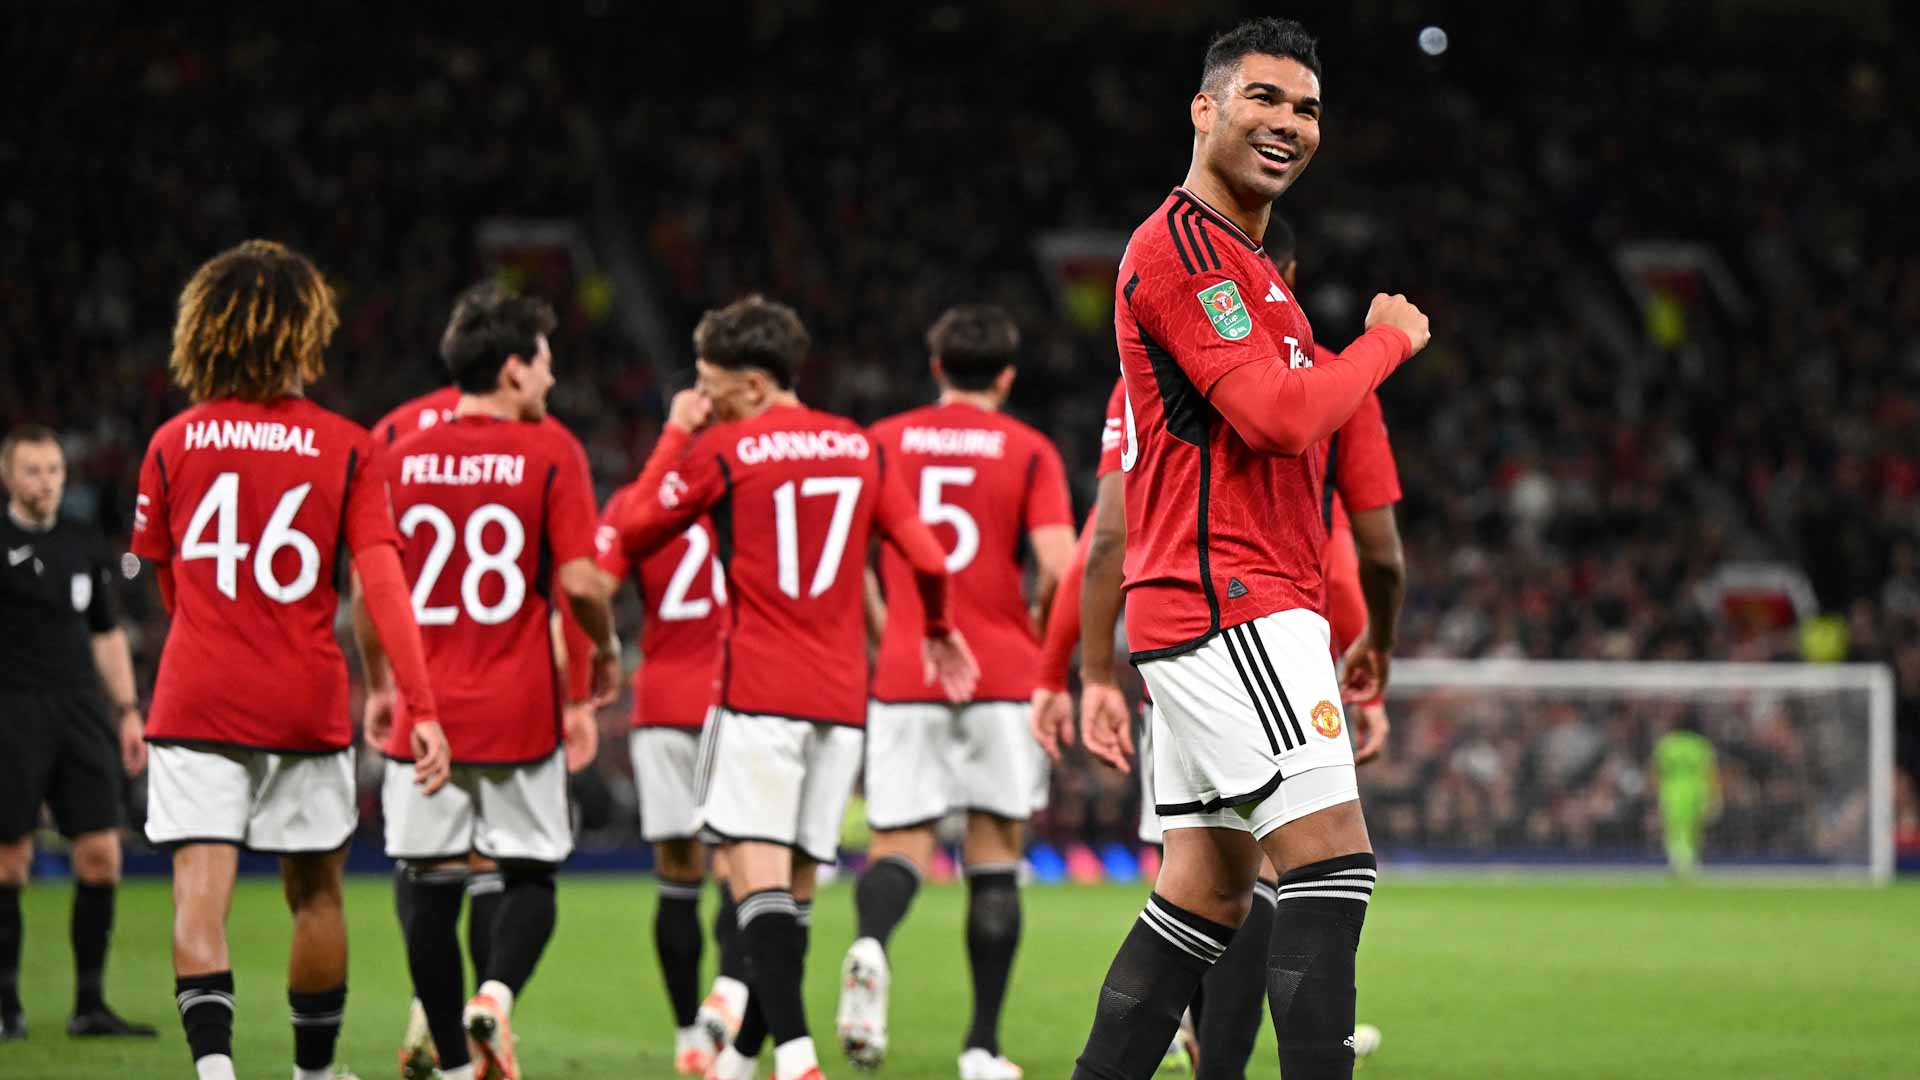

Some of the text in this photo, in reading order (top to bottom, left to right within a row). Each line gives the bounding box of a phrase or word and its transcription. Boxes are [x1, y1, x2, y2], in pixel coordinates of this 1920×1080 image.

[184, 419, 320, 457] HANNIBAL
[401, 453, 526, 486] PELLISTRI
[736, 429, 870, 465] GARNACHO
[180, 472, 320, 604] 46
[399, 503, 527, 626] 28
[773, 476, 864, 600] 17
[918, 465, 980, 574] 5
